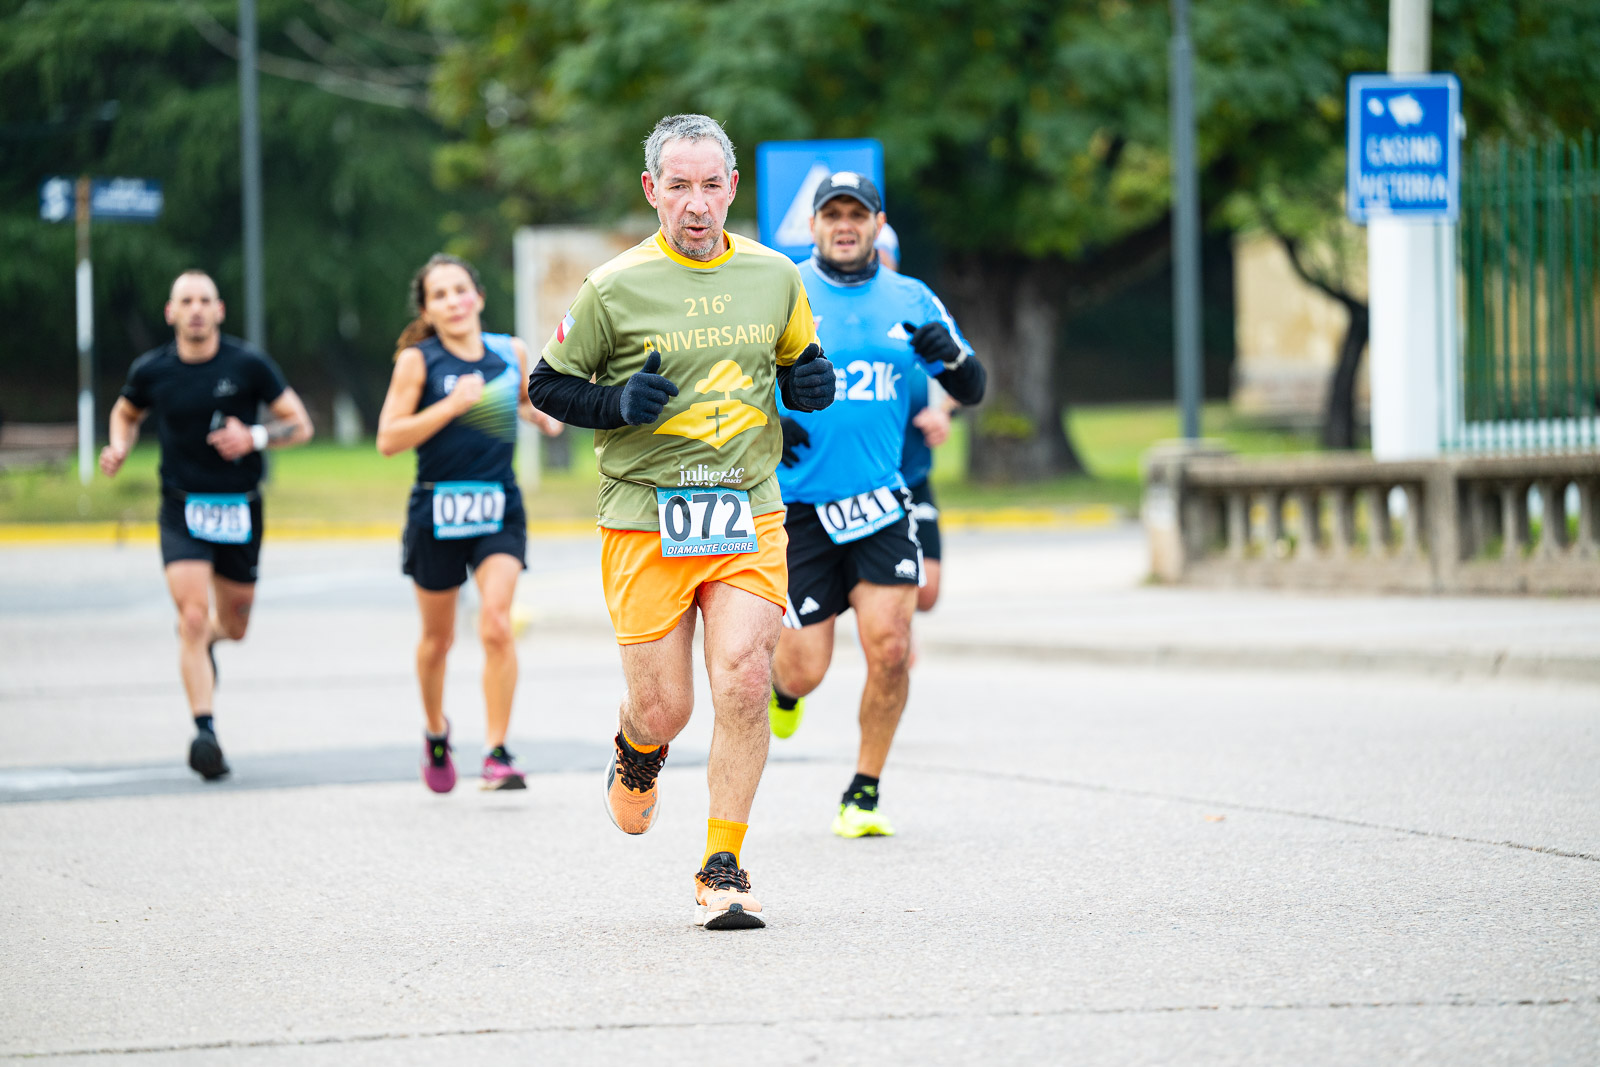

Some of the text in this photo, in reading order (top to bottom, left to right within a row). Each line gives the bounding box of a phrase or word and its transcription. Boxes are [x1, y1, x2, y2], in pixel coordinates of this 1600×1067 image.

[684, 294, 732, 317] 216°
[643, 324, 776, 355] ANIVERSARIO
[441, 491, 496, 524] 020
[664, 493, 749, 542] 072
[825, 490, 887, 531] 041
[667, 541, 754, 555] DIAMANTE CORRE
